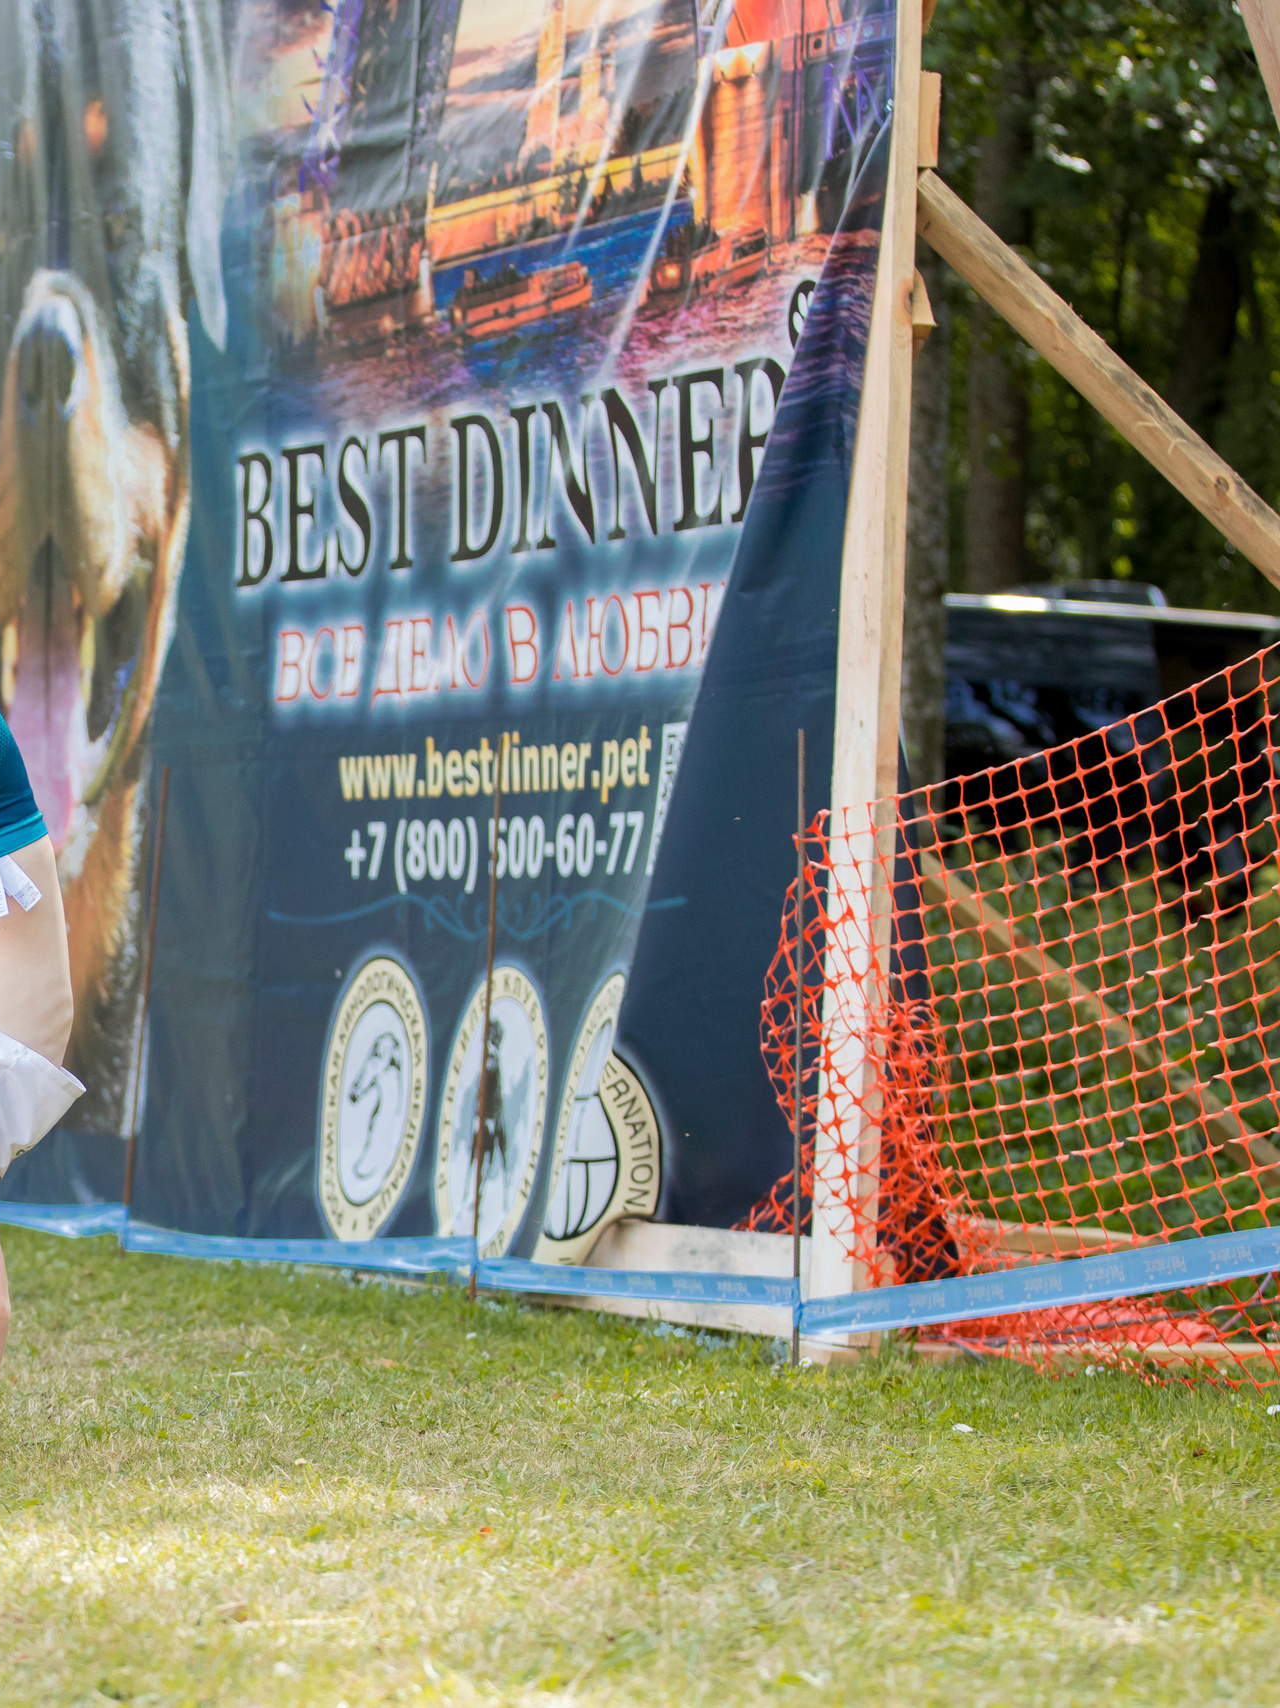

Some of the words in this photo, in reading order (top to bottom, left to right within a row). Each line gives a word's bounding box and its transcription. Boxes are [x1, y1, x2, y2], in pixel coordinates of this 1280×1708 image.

[237, 425, 427, 587] BEST
[275, 624, 365, 702] ВСЕ
[371, 610, 490, 710] ДЕЛО
[505, 606, 539, 684] В
[345, 821, 387, 880] +7
[394, 816, 479, 895] (800)
[488, 811, 645, 880] 500-60-77
[504, 973, 539, 1022] КЛУБ
